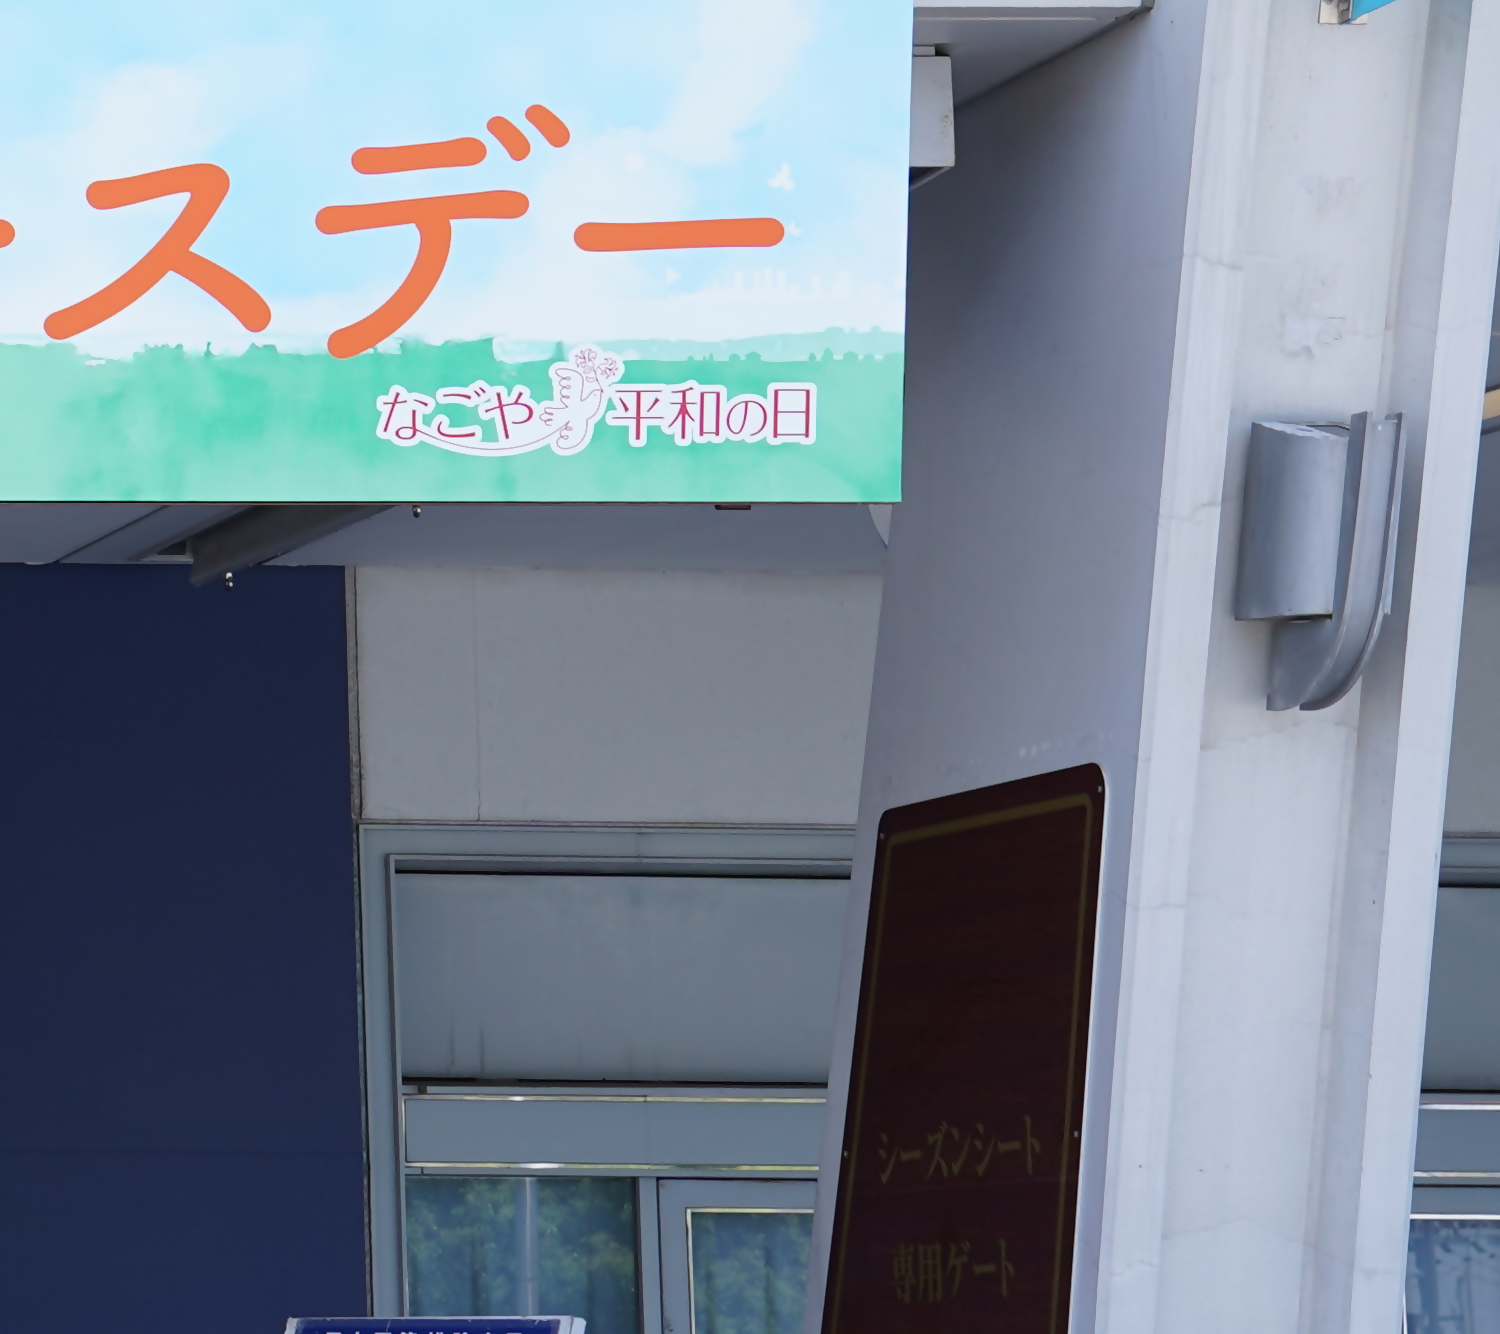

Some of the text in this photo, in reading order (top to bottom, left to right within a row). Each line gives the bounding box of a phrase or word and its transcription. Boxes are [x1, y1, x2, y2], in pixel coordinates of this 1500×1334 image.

[383, 386, 811, 440] なごや 平和の日
[878, 1114, 1041, 1185] シーズンシート
[891, 1237, 1015, 1304] 専用ゲート
